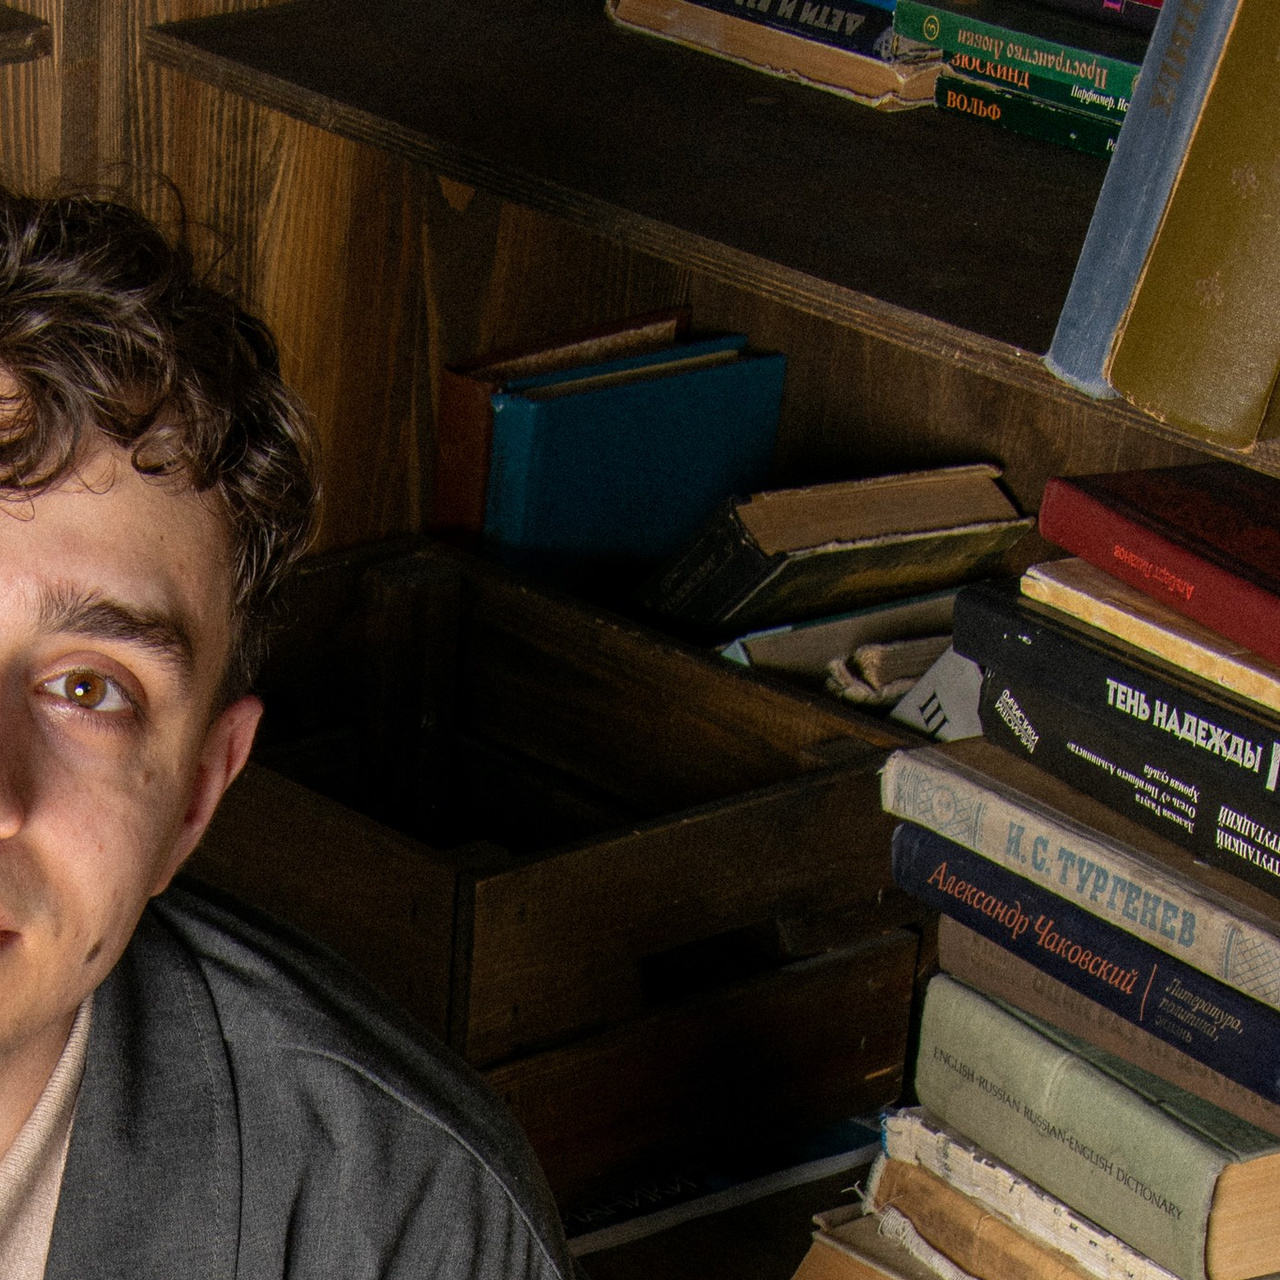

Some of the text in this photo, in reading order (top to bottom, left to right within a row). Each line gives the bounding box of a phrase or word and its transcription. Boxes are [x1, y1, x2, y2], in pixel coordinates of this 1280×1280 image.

[799, 2, 866, 36] ДЕТИ
[958, 29, 1108, 90] Пространство Любви
[946, 90, 1002, 121] ВОЛЬФ
[1106, 678, 1151, 721] ТЕНЬ
[1152, 700, 1263, 773] НАДЕЖДЫ
[1005, 822, 1197, 948] И. С. ТУРГЕНЕВ
[927, 861, 1030, 940] Александр
[1034, 915, 1139, 995] Чаковский
[1159, 998, 1219, 1042] политика,
[1165, 978, 1243, 1035] Литература,
[1023, 1105, 1113, 1176] RUSSIAN-ENGLISH
[1115, 1167, 1184, 1221] DICTIONARY
